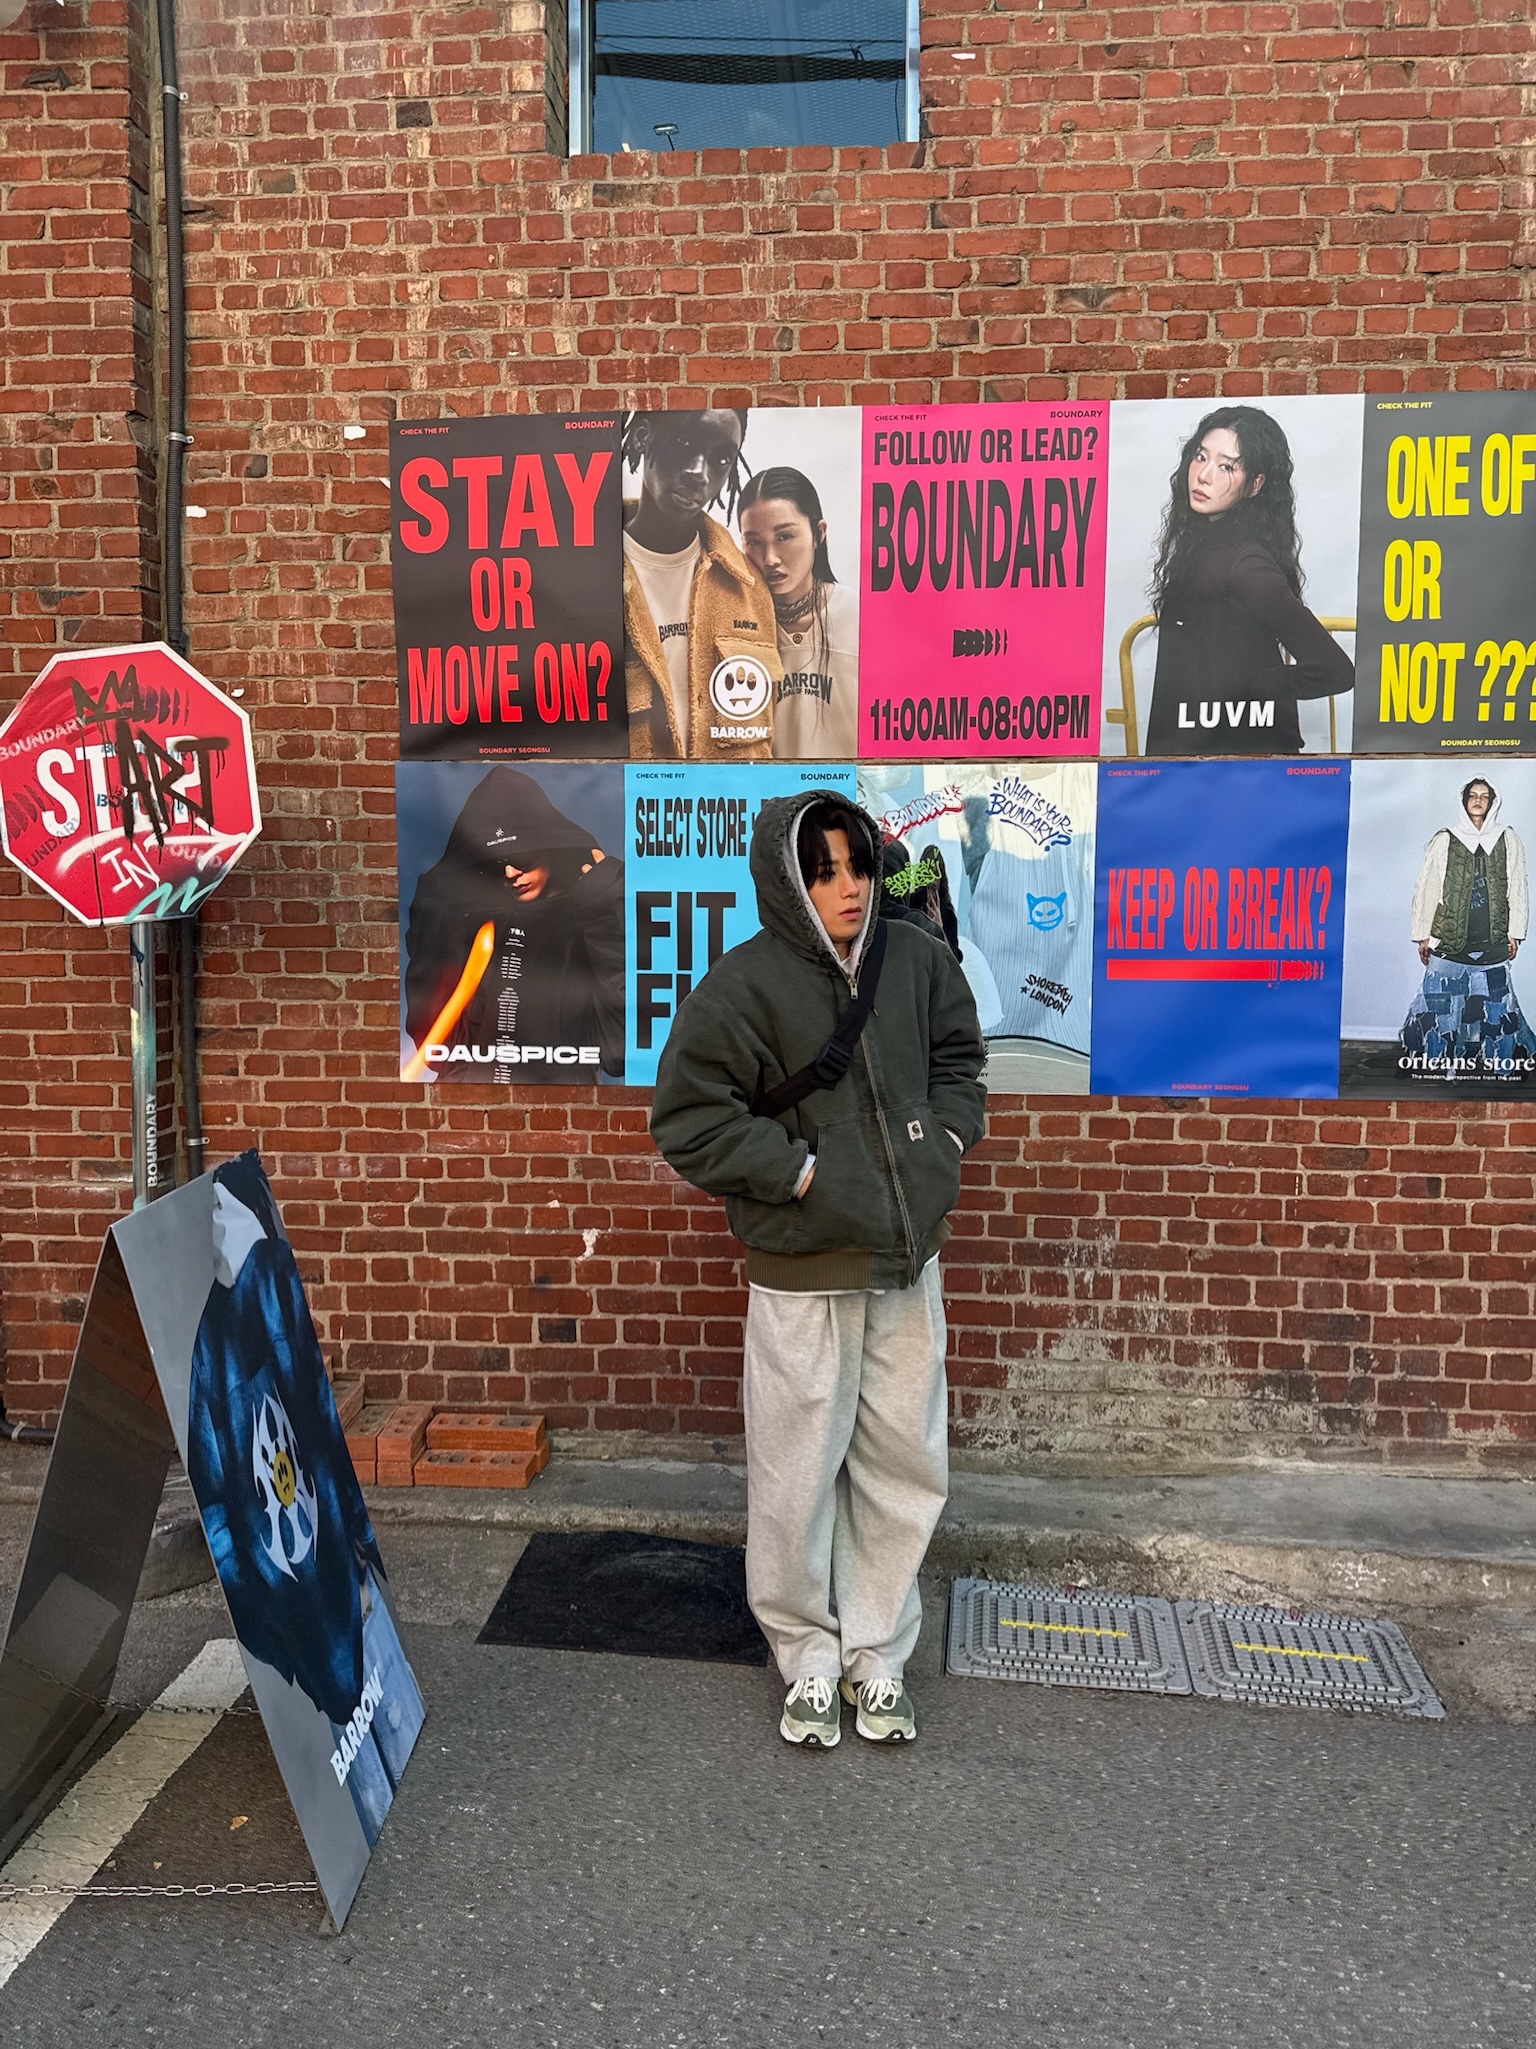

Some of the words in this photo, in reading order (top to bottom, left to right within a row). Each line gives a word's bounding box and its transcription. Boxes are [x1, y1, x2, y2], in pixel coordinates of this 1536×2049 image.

[565, 420, 615, 430] BOUNDARY
[1050, 410, 1103, 419] BOUNDARY
[1377, 402, 1402, 410] CHECK
[1420, 401, 1433, 409] FIT
[874, 430, 972, 466] FOLLOW
[980, 428, 1012, 464] OR
[1021, 426, 1099, 462] LEAD?
[1387, 435, 1472, 519] ONE
[1481, 433, 1536, 517] OF
[400, 451, 614, 554] STAY
[870, 477, 1097, 593] BOUNDARY
[470, 557, 535, 632] OR
[1383, 539, 1442, 622] OR
[658, 622, 688, 643] BARRO
[407, 645, 522, 726] MOVE
[533, 641, 612, 723] ON?
[1379, 641, 1466, 724] NOT
[710, 727, 767, 739] BARROW
[870, 695, 1090, 742] 11:00AM-08:00PM
[1178, 701, 1275, 728] LUVM
[801, 773, 850, 781] BOUNDARY
[1003, 776, 1035, 805] WHAT
[1286, 767, 1340, 776] BOUNDARY
[635, 796, 693, 858] SELECT
[697, 796, 747, 858] STORE
[884, 784, 965, 841] BOUNDARY
[100, 842, 160, 893] IN
[636, 891, 736, 971] FIT
[1107, 867, 1175, 950] KEEP
[1183, 866, 1219, 952] OR
[1227, 865, 1332, 950] BREAK?
[1030, 988, 1068, 1017] LONDON
[424, 1044, 600, 1064] DAUSPICE
[1398, 1052, 1477, 1071] orleans
[1483, 1057, 1536, 1071] store
[145, 1093, 158, 1188] BOUNDARY
[329, 1665, 384, 1787] BARROW
